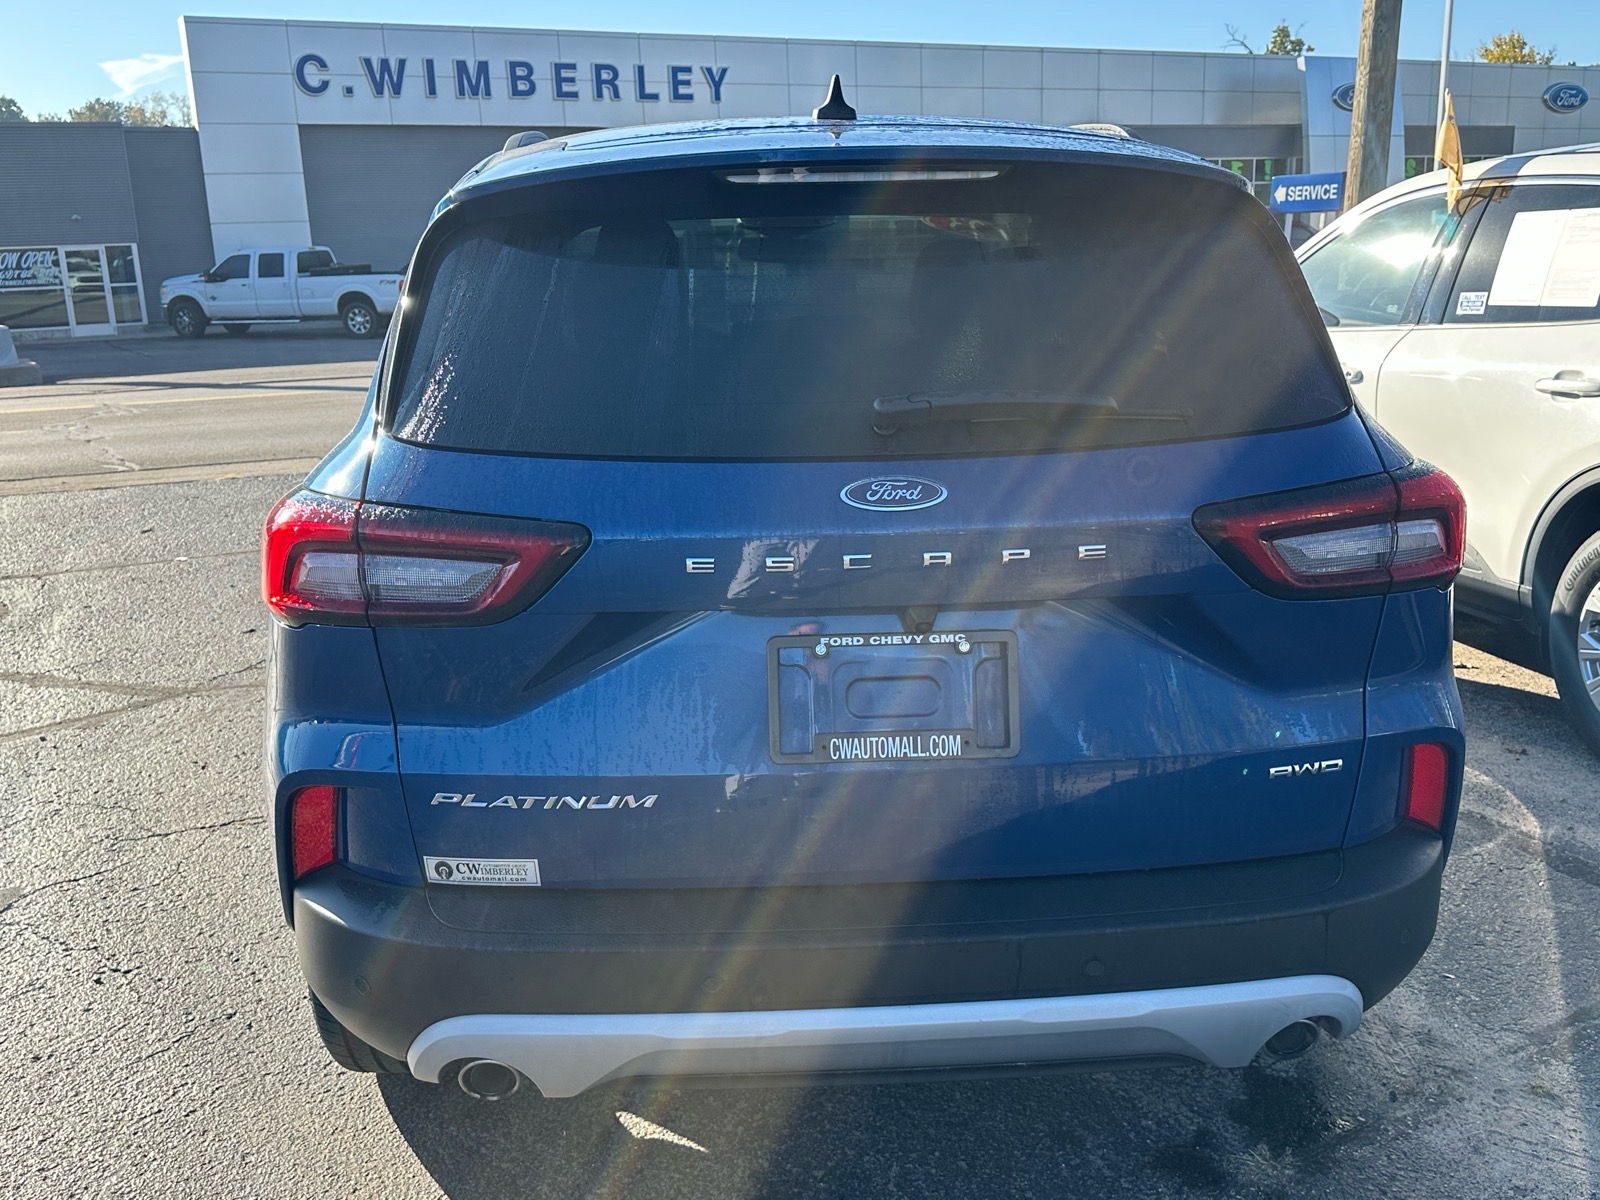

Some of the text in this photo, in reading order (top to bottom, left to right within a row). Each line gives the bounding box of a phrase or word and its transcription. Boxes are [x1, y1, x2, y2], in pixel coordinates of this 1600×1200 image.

[293, 53, 730, 104] C.WIMBERLEY
[1556, 89, 1583, 106] Ford
[1287, 184, 1339, 201] SERVICE
[0, 250, 55, 269] OW OPEN
[866, 481, 923, 501] Ford
[685, 543, 1107, 574] ESCAPE
[1564, 544, 1600, 591] Continen
[820, 633, 966, 647] FORD CHEVY GMC
[830, 735, 962, 760] CWAUTOMALL.COM
[1269, 758, 1343, 779] AWD
[430, 792, 659, 810] PLATINUM
